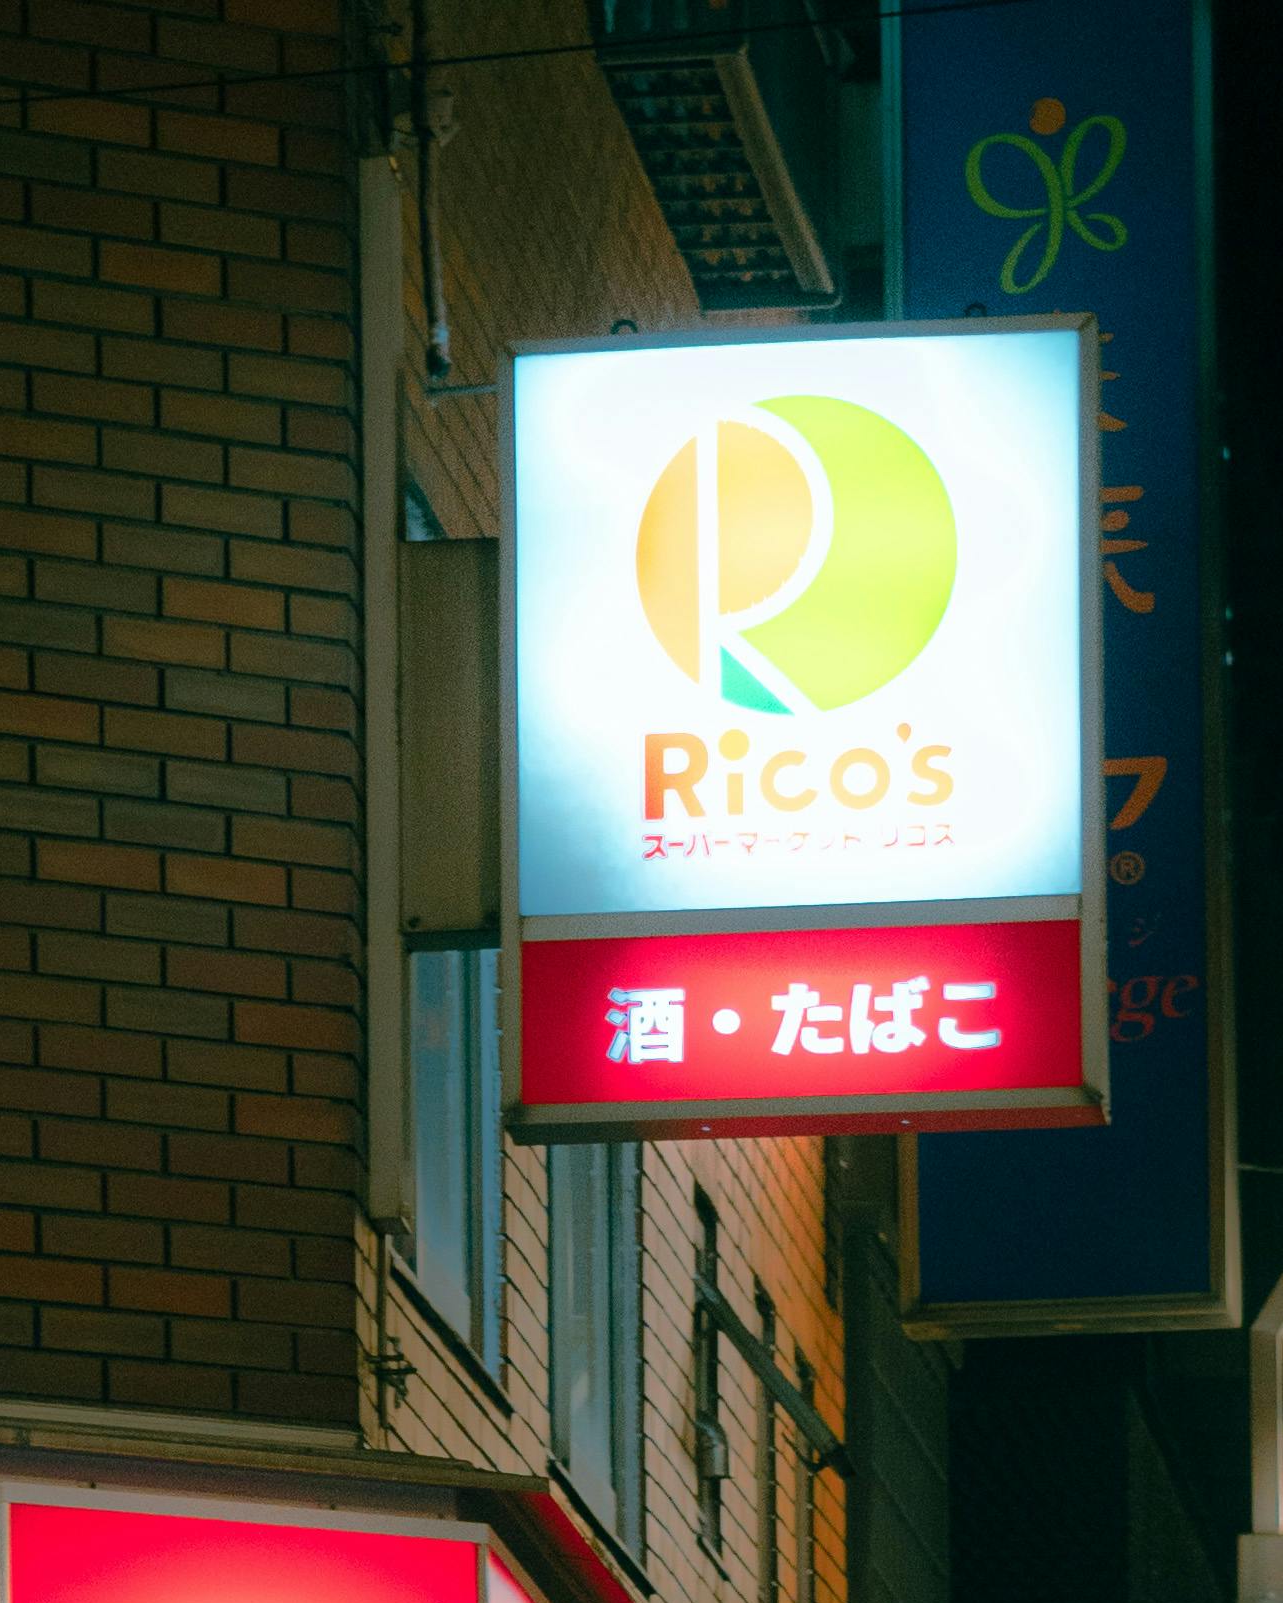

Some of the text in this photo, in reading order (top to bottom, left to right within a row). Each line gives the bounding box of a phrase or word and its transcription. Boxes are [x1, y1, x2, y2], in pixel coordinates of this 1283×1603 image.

[644, 721, 954, 821] Rico's
[605, 975, 1003, 1065] 酒・たばこ
